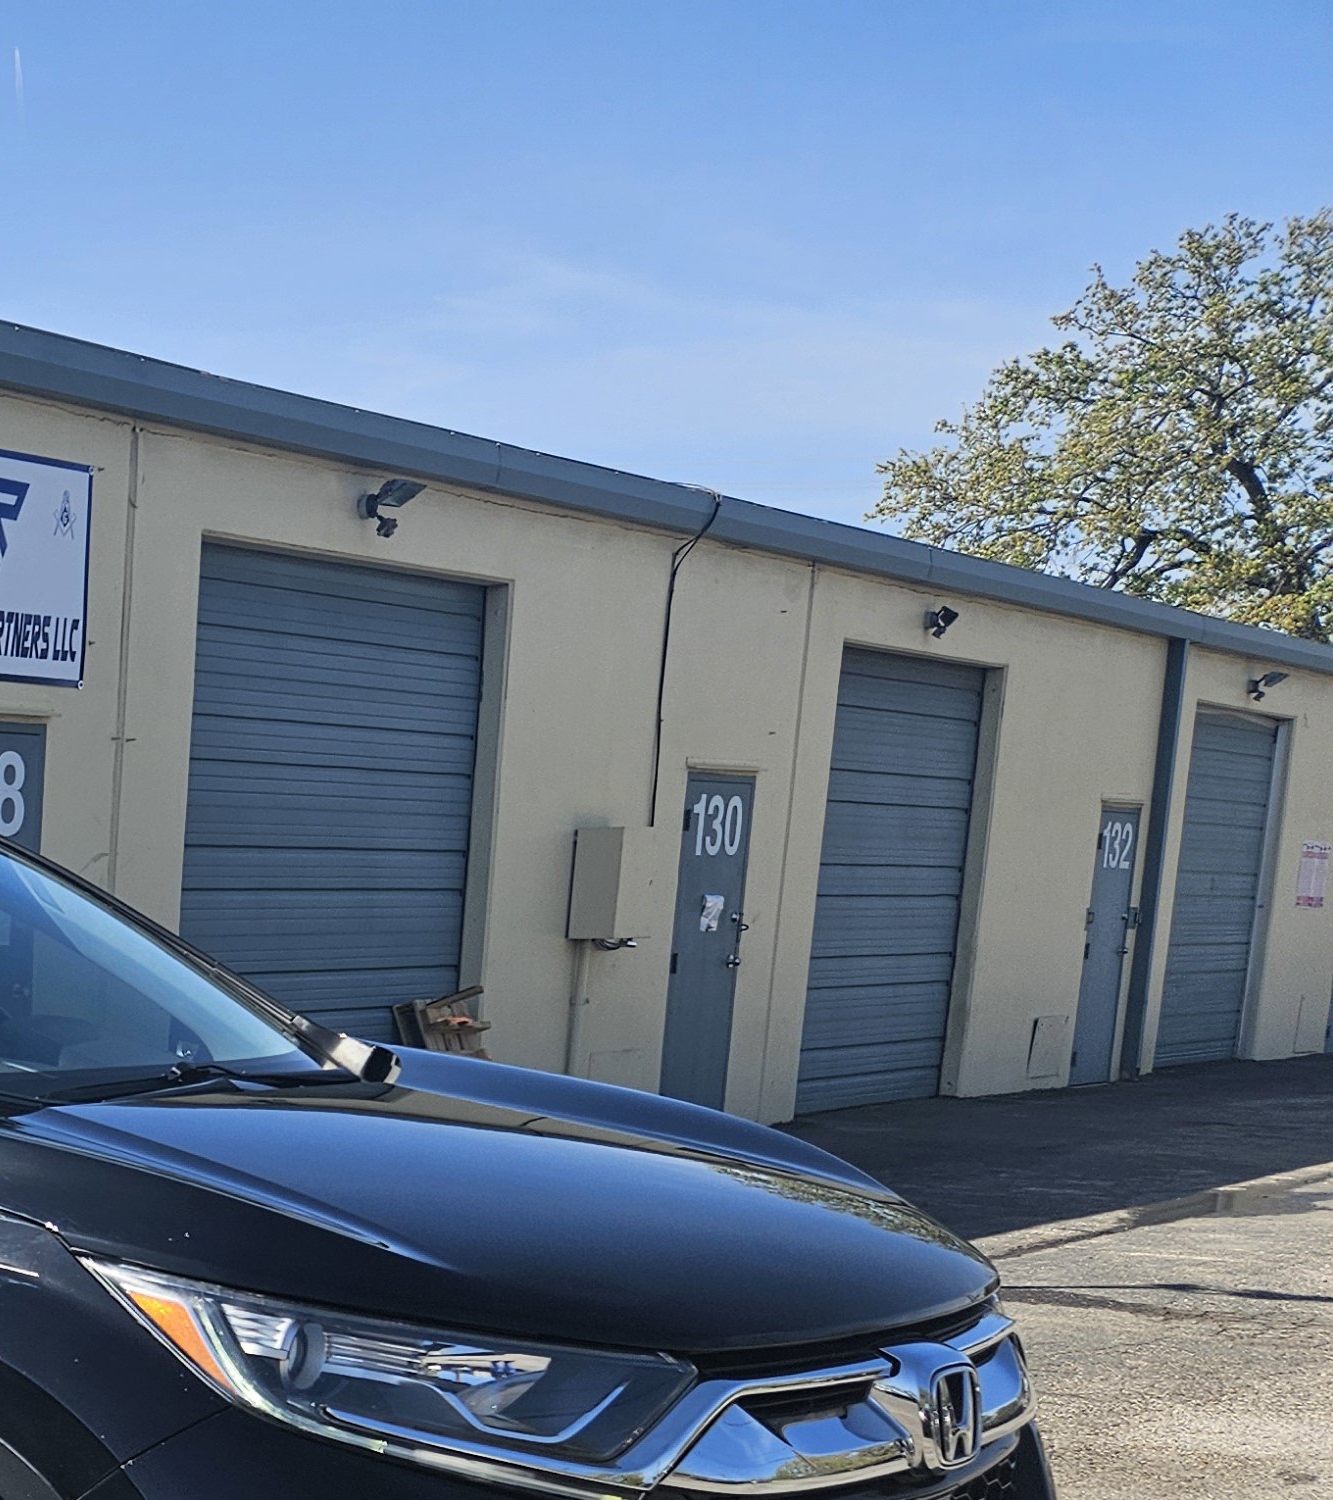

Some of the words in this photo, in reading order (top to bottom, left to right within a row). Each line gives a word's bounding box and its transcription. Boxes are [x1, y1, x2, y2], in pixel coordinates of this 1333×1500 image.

[52, 616, 80, 663] LLC
[693, 793, 743, 856] 130
[1102, 821, 1133, 869] 132
